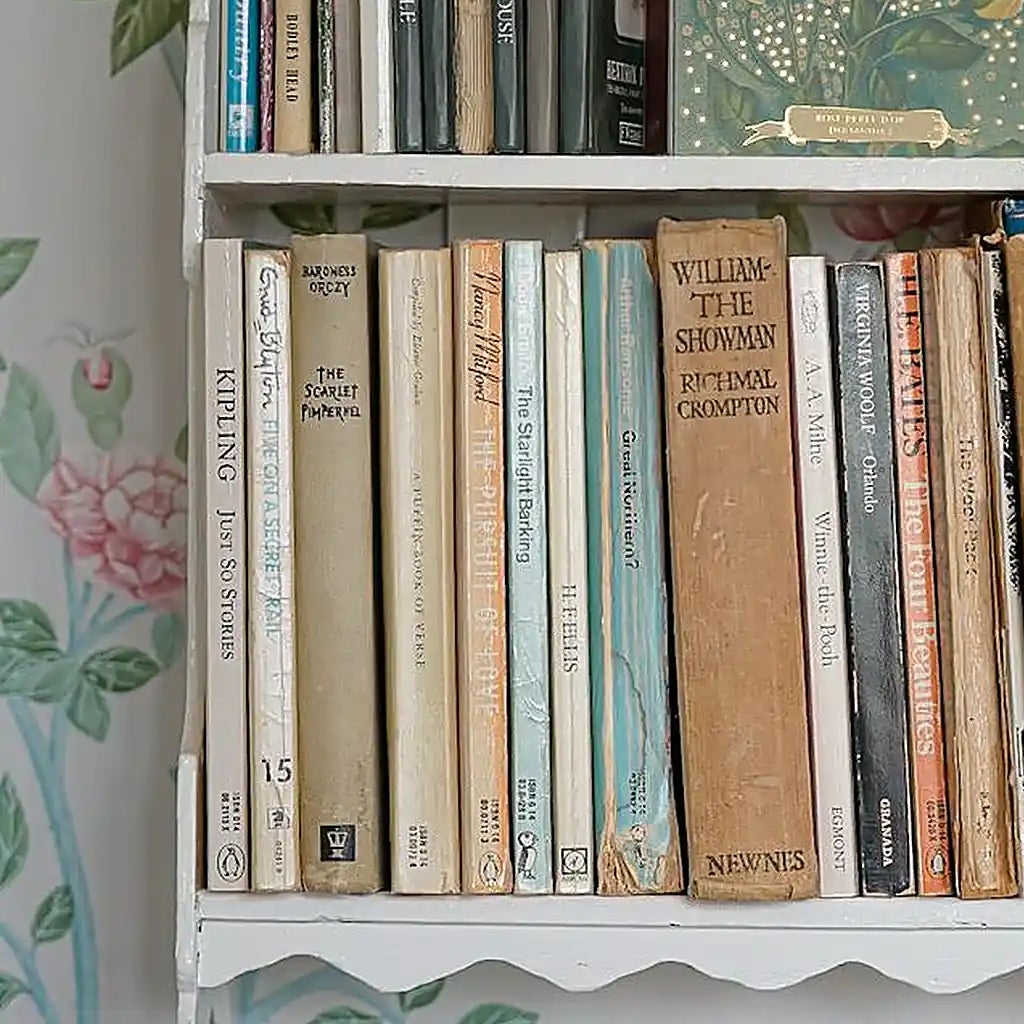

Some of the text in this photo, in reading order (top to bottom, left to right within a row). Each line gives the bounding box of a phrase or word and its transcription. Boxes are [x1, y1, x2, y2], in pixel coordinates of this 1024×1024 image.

[285, 14, 299, 103] BODLEY HEAD
[302, 265, 357, 279] BARONESS
[309, 281, 351, 298] ORCZY
[690, 291, 754, 318] THE
[898, 311, 920, 339] E.
[254, 267, 283, 410] Enid Blyton
[468, 272, 502, 407] Nancy Mitford
[675, 324, 776, 355] SHOWMAN
[304, 383, 359, 402] SCARLET
[316, 366, 345, 384] THE
[680, 368, 778, 394] RICHMAL
[301, 402, 362, 423] PIMPERNEL
[517, 386, 533, 418] The
[677, 394, 780, 419] CROMPTON
[805, 360, 826, 465] A. A. Milne
[855, 284, 879, 513] VIRGINIA WOOLF Orlando
[899, 348, 927, 457] BATES
[263, 419, 279, 457] FIVE
[515, 422, 534, 494] Starlight
[622, 430, 637, 477] Great
[263, 463, 279, 495] ON
[216, 368, 237, 661] KIPLING JUST SO STORIES
[264, 500, 280, 513] A
[622, 481, 640, 569] Northern?
[515, 498, 534, 564] Barking
[471, 428, 500, 716] THE PURSUIT OF LOVE
[814, 511, 840, 667] Winnie-the-Pooh
[903, 480, 941, 756] The Four Beauties
[414, 623, 425, 669] VERSE
[562, 623, 578, 674] ELLIS
[260, 758, 292, 784] 15
[831, 807, 846, 872] EGMONT
[880, 798, 893, 867] GRANADA
[706, 850, 805, 876] NEWNES
